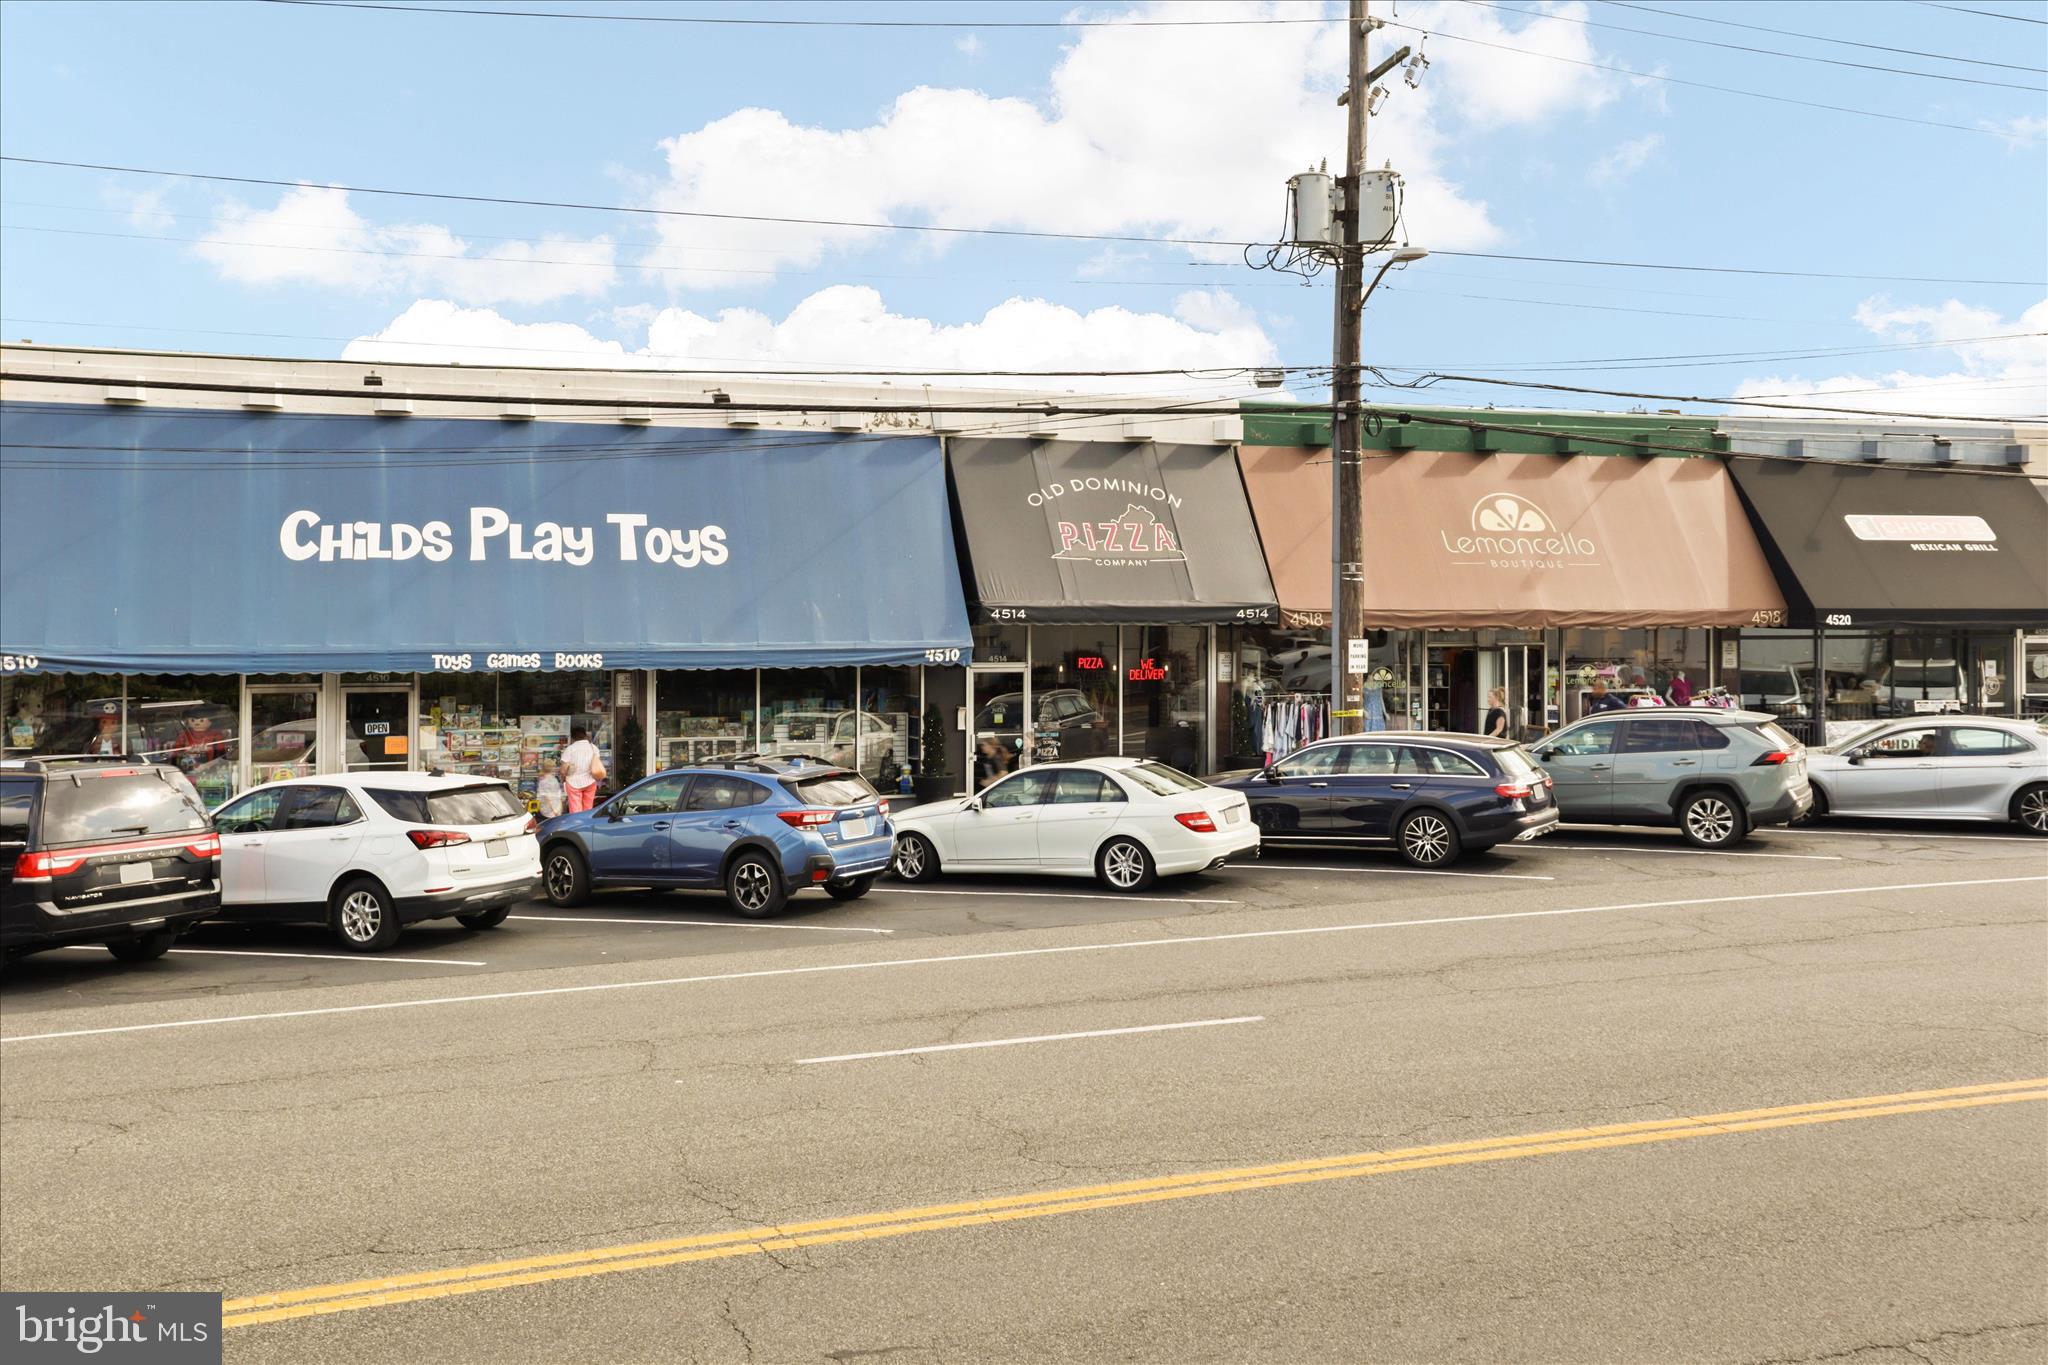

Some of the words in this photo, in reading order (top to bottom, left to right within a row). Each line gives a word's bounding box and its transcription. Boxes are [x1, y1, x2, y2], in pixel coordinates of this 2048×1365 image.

[1027, 484, 1065, 507] OLD
[1070, 477, 1183, 509] DOMINION
[1058, 521, 1177, 552] PIZZA
[1440, 530, 1596, 556] Lemoncello
[1911, 543, 1963, 552] MEXICAN
[1964, 543, 1999, 552] GRILL
[1095, 558, 1149, 568] COMPANY
[1490, 558, 1565, 569] BOUTIQUE
[990, 608, 1027, 620] 4514
[1236, 608, 1270, 619] 4514
[1289, 612, 1324, 627] 4518
[1825, 613, 1852, 626] 4520
[924, 648, 961, 663] 4510
[988, 654, 1008, 663] 4514
[0, 654, 39, 671] 510
[1078, 657, 1104, 669] PIZZA
[1140, 658, 1155, 670] WE
[366, 673, 391, 682] 4510
[1129, 668, 1165, 681] DELIVER
[366, 722, 389, 734] OPEN
[64, 891, 104, 902] NAVIGATOR
